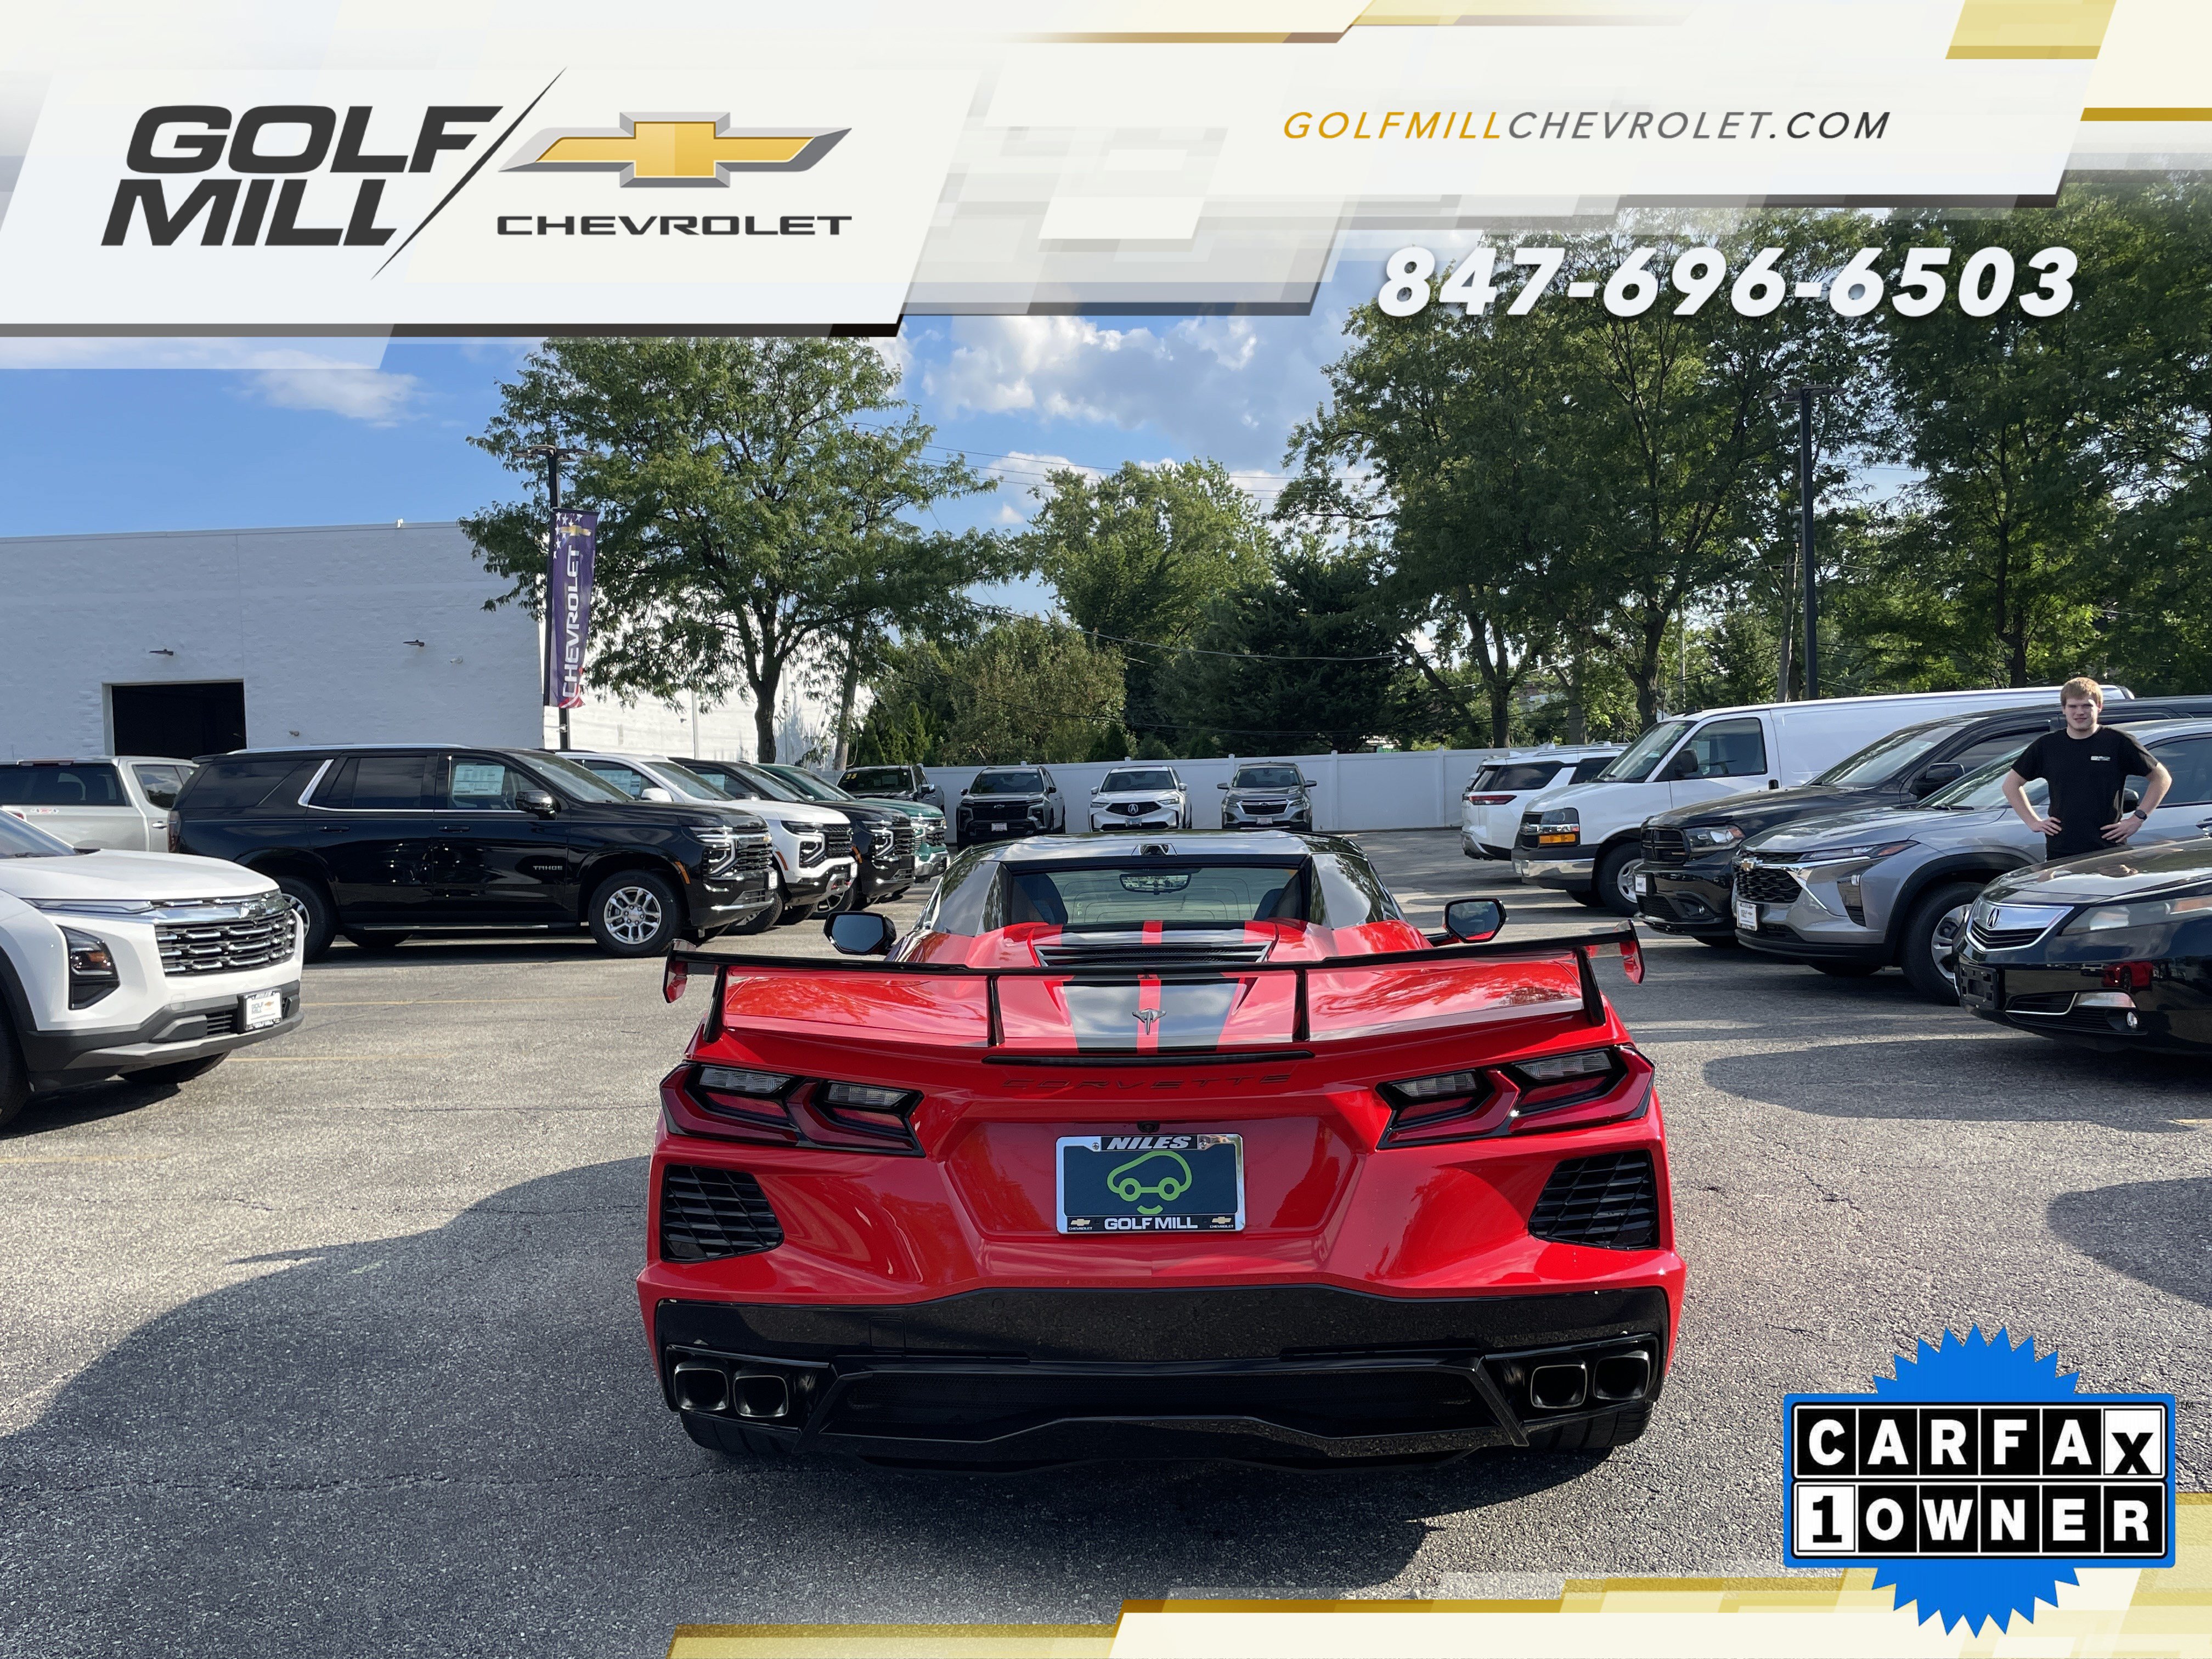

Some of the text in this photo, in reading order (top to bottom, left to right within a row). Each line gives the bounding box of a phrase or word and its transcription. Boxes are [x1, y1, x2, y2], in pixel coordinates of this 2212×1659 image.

[562, 544, 580, 698] CHEVROLET
[1002, 1073, 1292, 1090] CORVETTE
[1107, 1136, 1192, 1150] NILES
[1104, 1217, 1198, 1230] GOLF MILL
